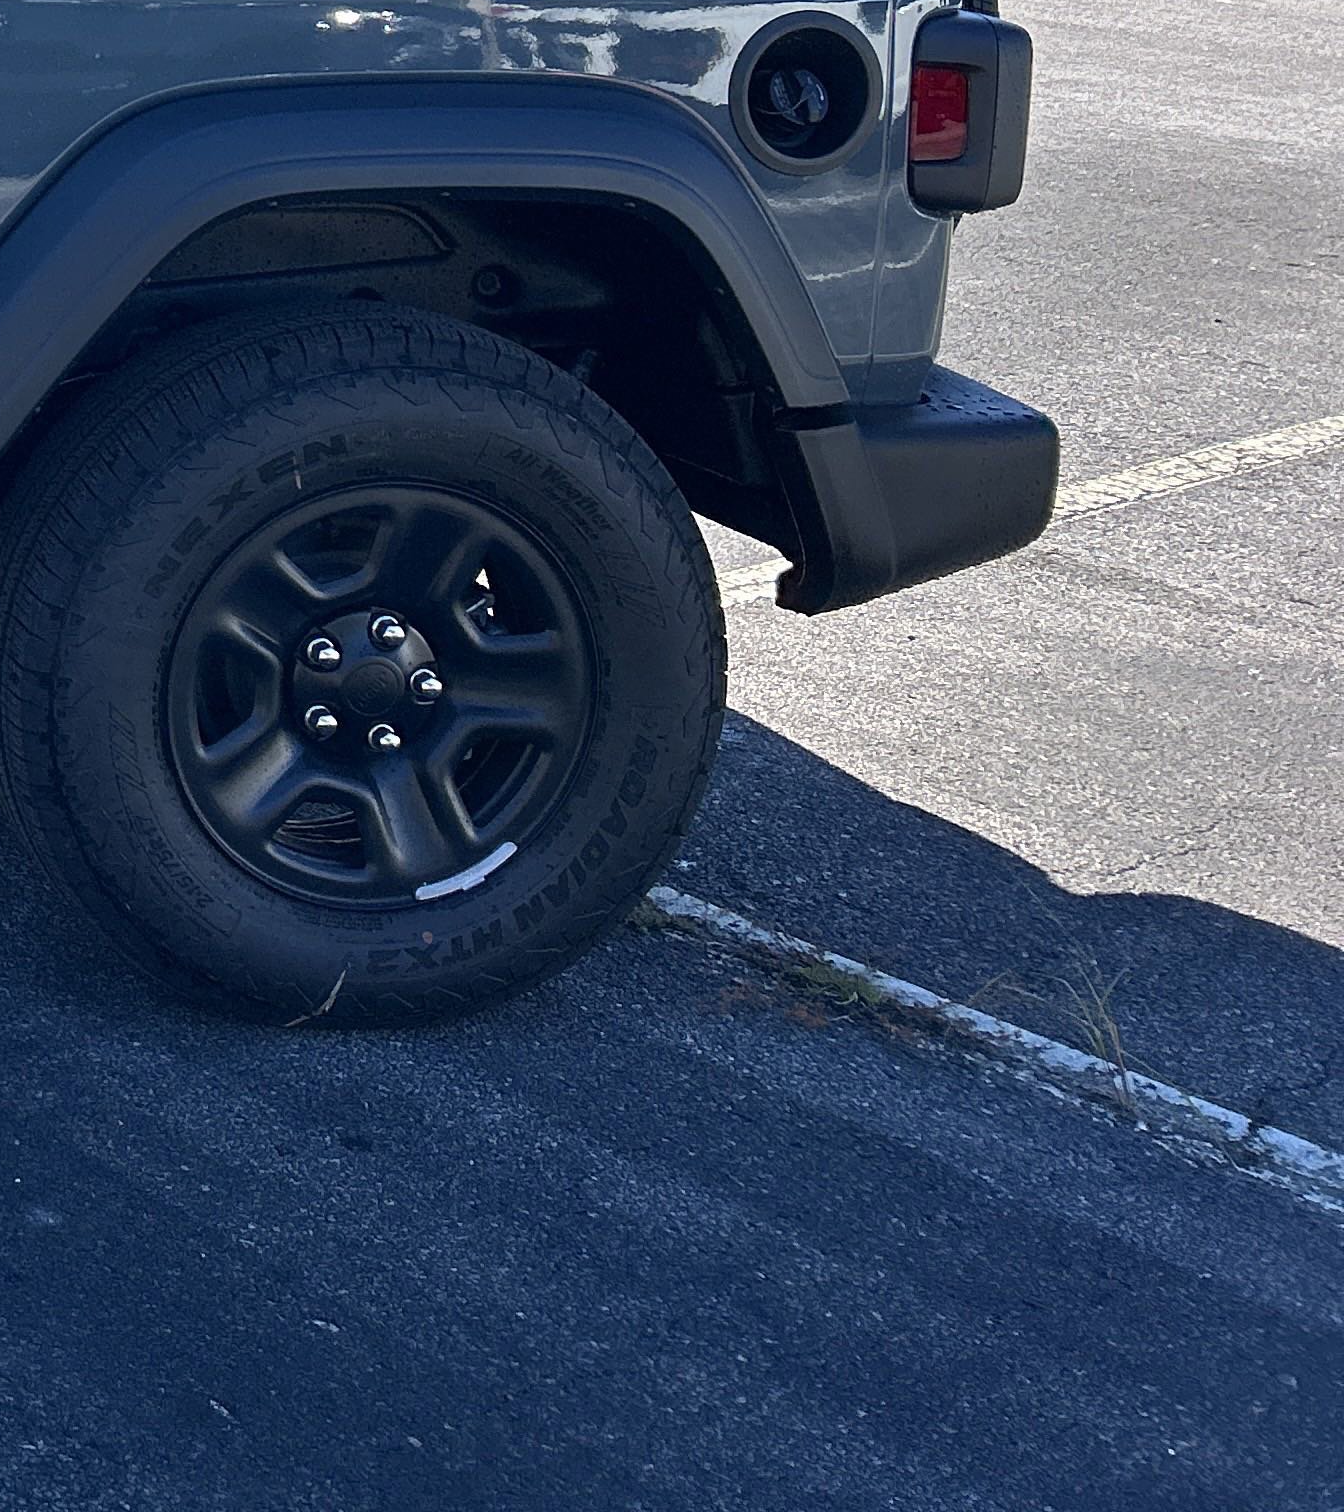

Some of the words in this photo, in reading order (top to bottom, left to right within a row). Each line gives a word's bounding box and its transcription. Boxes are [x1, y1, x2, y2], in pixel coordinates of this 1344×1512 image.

[142, 433, 348, 600] NEXEN
[512, 734, 658, 934] ROADIAN
[367, 918, 505, 974] HTX2
